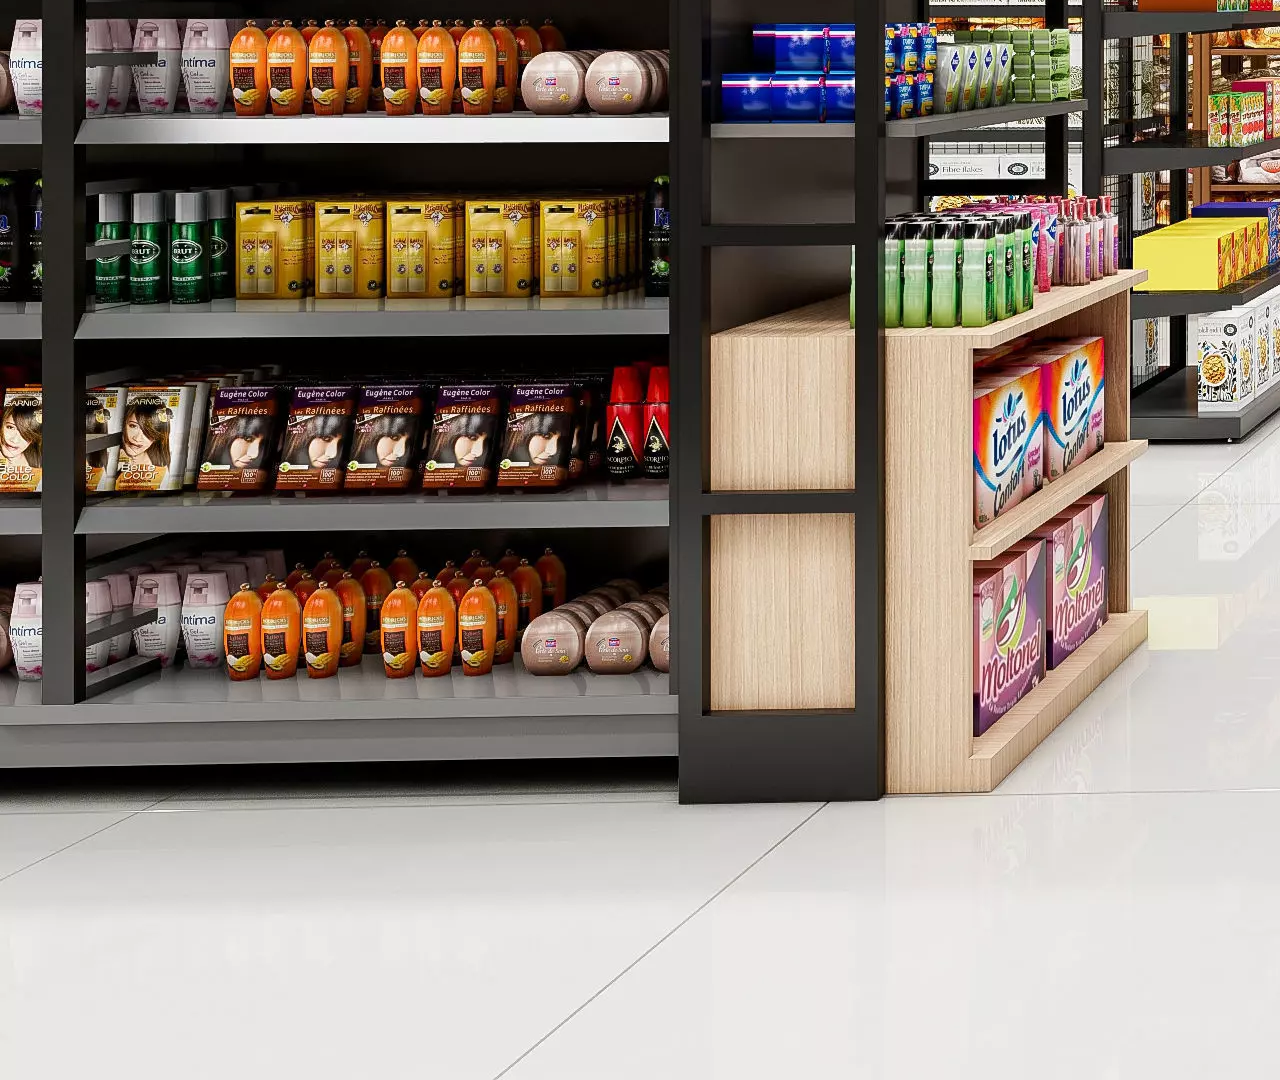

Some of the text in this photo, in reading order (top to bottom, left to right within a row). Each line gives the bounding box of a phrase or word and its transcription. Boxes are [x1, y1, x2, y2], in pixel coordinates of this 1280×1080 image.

[942, 165, 983, 173] Fibre flakes
[219, 390, 268, 399] Eugène Color
[297, 390, 346, 399] Eugène Color
[365, 389, 392, 398] Eugène
[442, 388, 490, 398] Eugène Color
[516, 387, 565, 397] Eugène Color
[1061, 376, 1091, 426] lotus
[992, 410, 1027, 467] lotus
[1062, 421, 1090, 473] Confort
[993, 460, 1026, 517] Confort
[1053, 566, 1105, 644] Moltonel
[979, 618, 1042, 707] Moltonel
